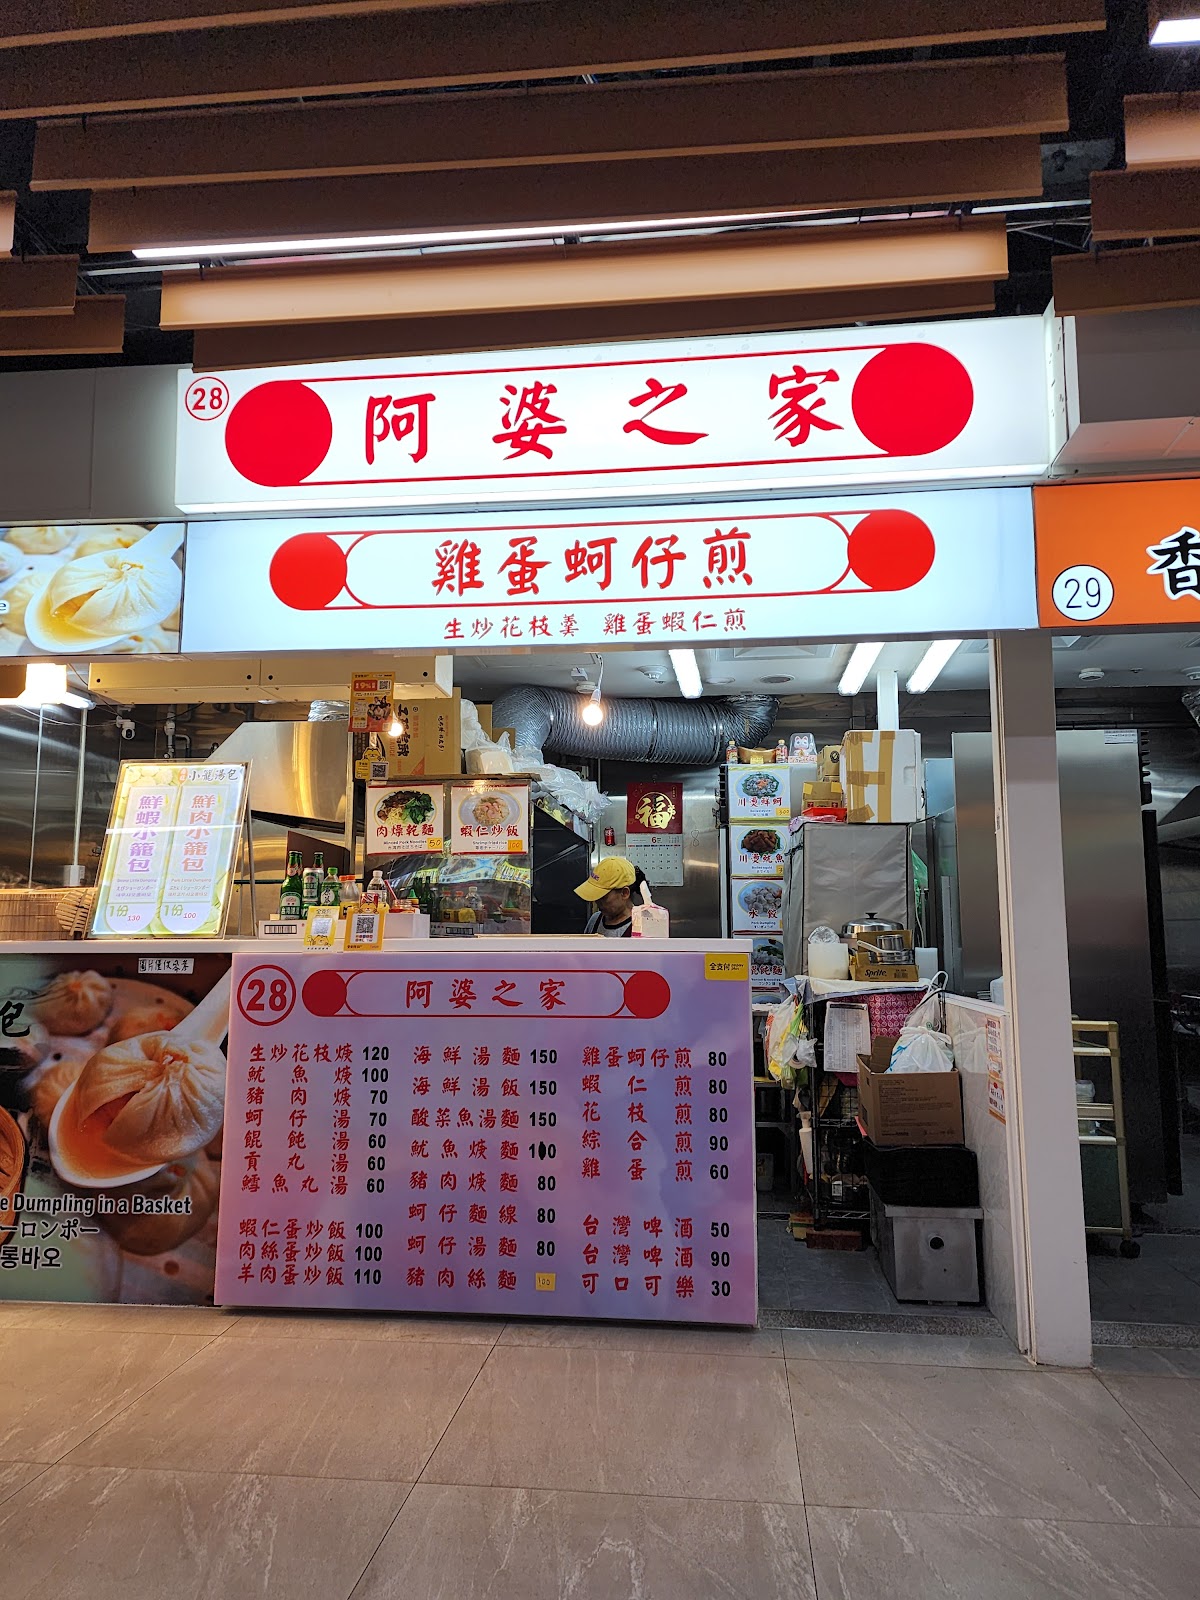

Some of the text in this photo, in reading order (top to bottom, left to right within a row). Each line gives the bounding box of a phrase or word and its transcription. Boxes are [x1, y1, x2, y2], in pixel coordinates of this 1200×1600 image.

[192, 387, 222, 410] 28
[366, 365, 844, 465] 阿婆之家
[432, 527, 752, 596] 雞蛋蚵仔煎
[1064, 577, 1101, 609] 29
[444, 609, 747, 639] 生炒花枝羹 雞蛋蝦仁煎
[128, 795, 163, 873] 鮮蝦小籠包
[181, 794, 216, 873] 鮮肉小籠包
[376, 821, 434, 837] 肉燥乾麵
[460, 826, 518, 836] 蝦仁炒飯
[651, 836, 657, 844] 6
[429, 839, 441, 847] 50
[865, 969, 888, 977] Sprite
[246, 980, 287, 1011] 28
[406, 978, 565, 1010] 阿婆之家
[363, 1047, 389, 1060] 120
[413, 1045, 557, 1067] 海鮮湯麵 150
[583, 1046, 726, 1069] 雞蛋蚵仔煎 80
[362, 1068, 388, 1082] 100
[583, 1075, 727, 1097] 蝦仁煎 80
[371, 1090, 387, 1104] 70
[412, 1077, 556, 1097] 海鮮湯飯 150
[245, 1109, 386, 1128] 蚵仔湯 70
[411, 1108, 556, 1128] 酸菜魚湯麵 150
[582, 1102, 727, 1125] 花枝煎 80
[244, 1131, 386, 1150] 餛飩湯 60
[582, 1130, 728, 1154] 綜合煎 90
[244, 1152, 385, 1172] 貢丸湯 60
[582, 1159, 728, 1182] 雞蛋煎 60
[241, 1174, 384, 1194] 鱈魚丸湯 60
[538, 1176, 555, 1190] 80
[14, 1194, 94, 1216] Dumpling
[100, 1195, 114, 1213] in
[119, 1200, 127, 1212] a
[133, 1195, 190, 1213] Basket
[409, 1203, 555, 1224] 蚵仔麵線 80
[239, 1219, 382, 1241] 蝦仁蛋炒飯 100
[583, 1214, 729, 1239] 台灣啤酒 50
[239, 1241, 382, 1263] 肉絲蛋炒飯 100
[408, 1235, 555, 1257] 蚵仔湯麵 80
[583, 1243, 729, 1267] 台灣啤酒 90
[1, 1246, 61, 1269] 롱바오
[237, 1264, 381, 1286] 羊肉蛋炒飯 110
[406, 1267, 516, 1289] 豬肉絲麵
[583, 1273, 730, 1297] 可口可樂 30
